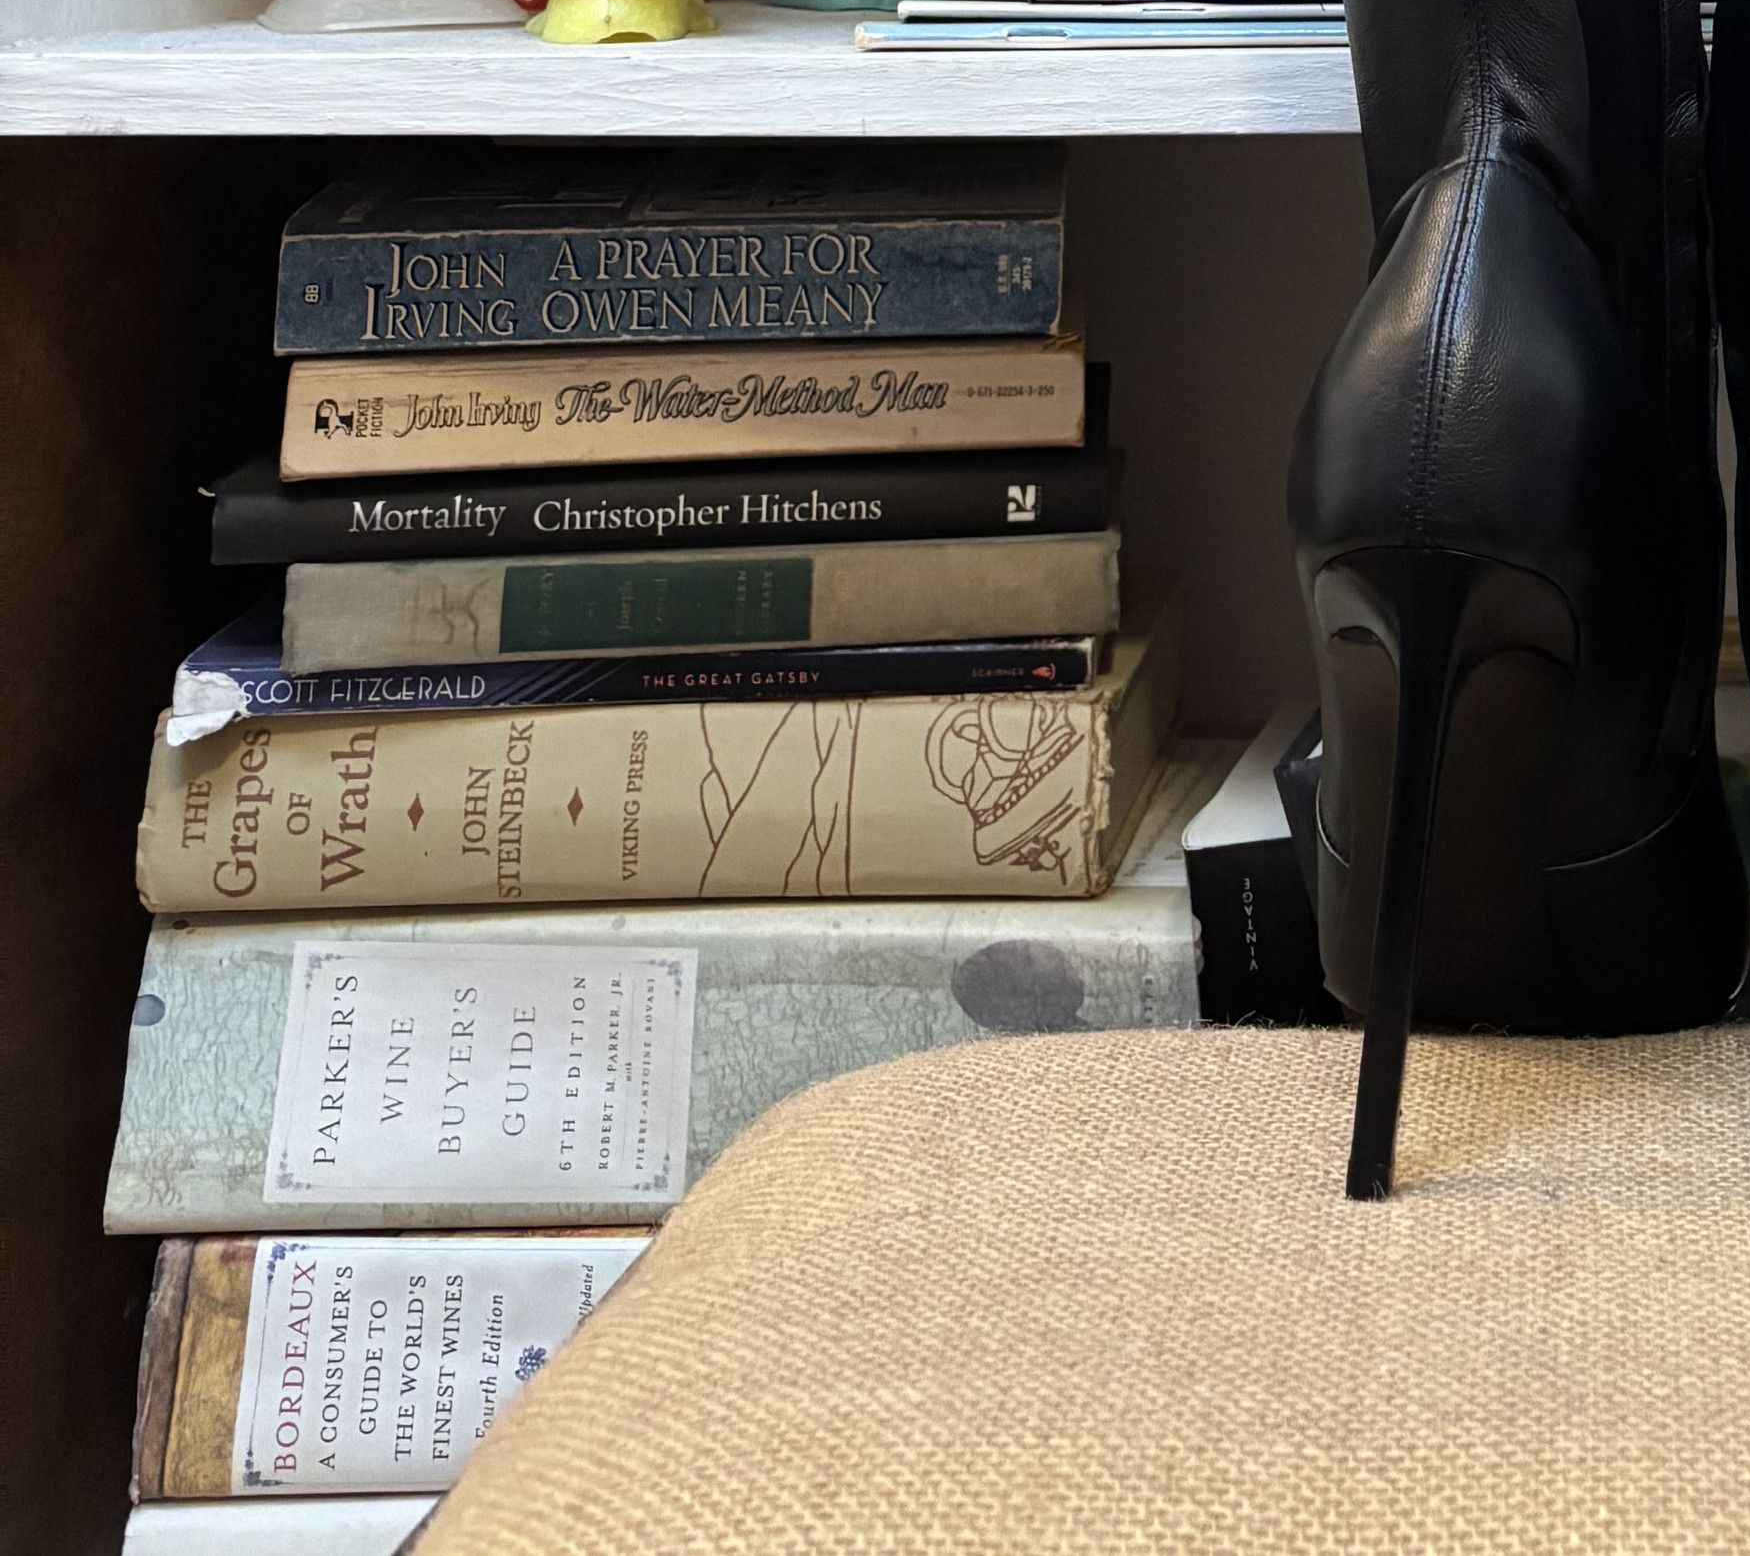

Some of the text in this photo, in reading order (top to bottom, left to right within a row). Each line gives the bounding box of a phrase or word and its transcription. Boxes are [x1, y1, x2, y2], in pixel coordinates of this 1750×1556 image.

[360, 283, 518, 341] IRVING
[387, 242, 507, 298] JOHN
[540, 282, 885, 335] OWEN MEANY
[548, 233, 882, 283] A PRAYER FOR
[355, 397, 369, 438] POCKET
[371, 396, 384, 438] FICTION
[349, 499, 506, 537] Mortality
[532, 491, 883, 541] Christopher Hitchens
[642, 670, 821, 690] THE GREAT GATSBY
[181, 780, 213, 849] THE
[213, 726, 274, 899] Grapes
[287, 792, 313, 837] OF
[321, 726, 379, 892] Wrath
[462, 766, 494, 856] JOHN
[498, 720, 535, 899] STEINBECK
[622, 729, 649, 882] VIKING PRESS
[1241, 877, 1258, 972] VINTAGE
[313, 974, 359, 1166] PARKER'S
[380, 1016, 416, 1124] WINE
[438, 987, 479, 1155] BUYER'S
[502, 1006, 537, 1136] GUIDE
[559, 976, 586, 1172] 6TH EDITION
[273, 1260, 318, 1473] BORDEAUX
[319, 1264, 355, 1471] A CONSUMER'S
[358, 1297, 389, 1436] GUIDE TO
[395, 1274, 428, 1462] THE WORLD'S
[432, 1274, 464, 1462] FINEST WINES
